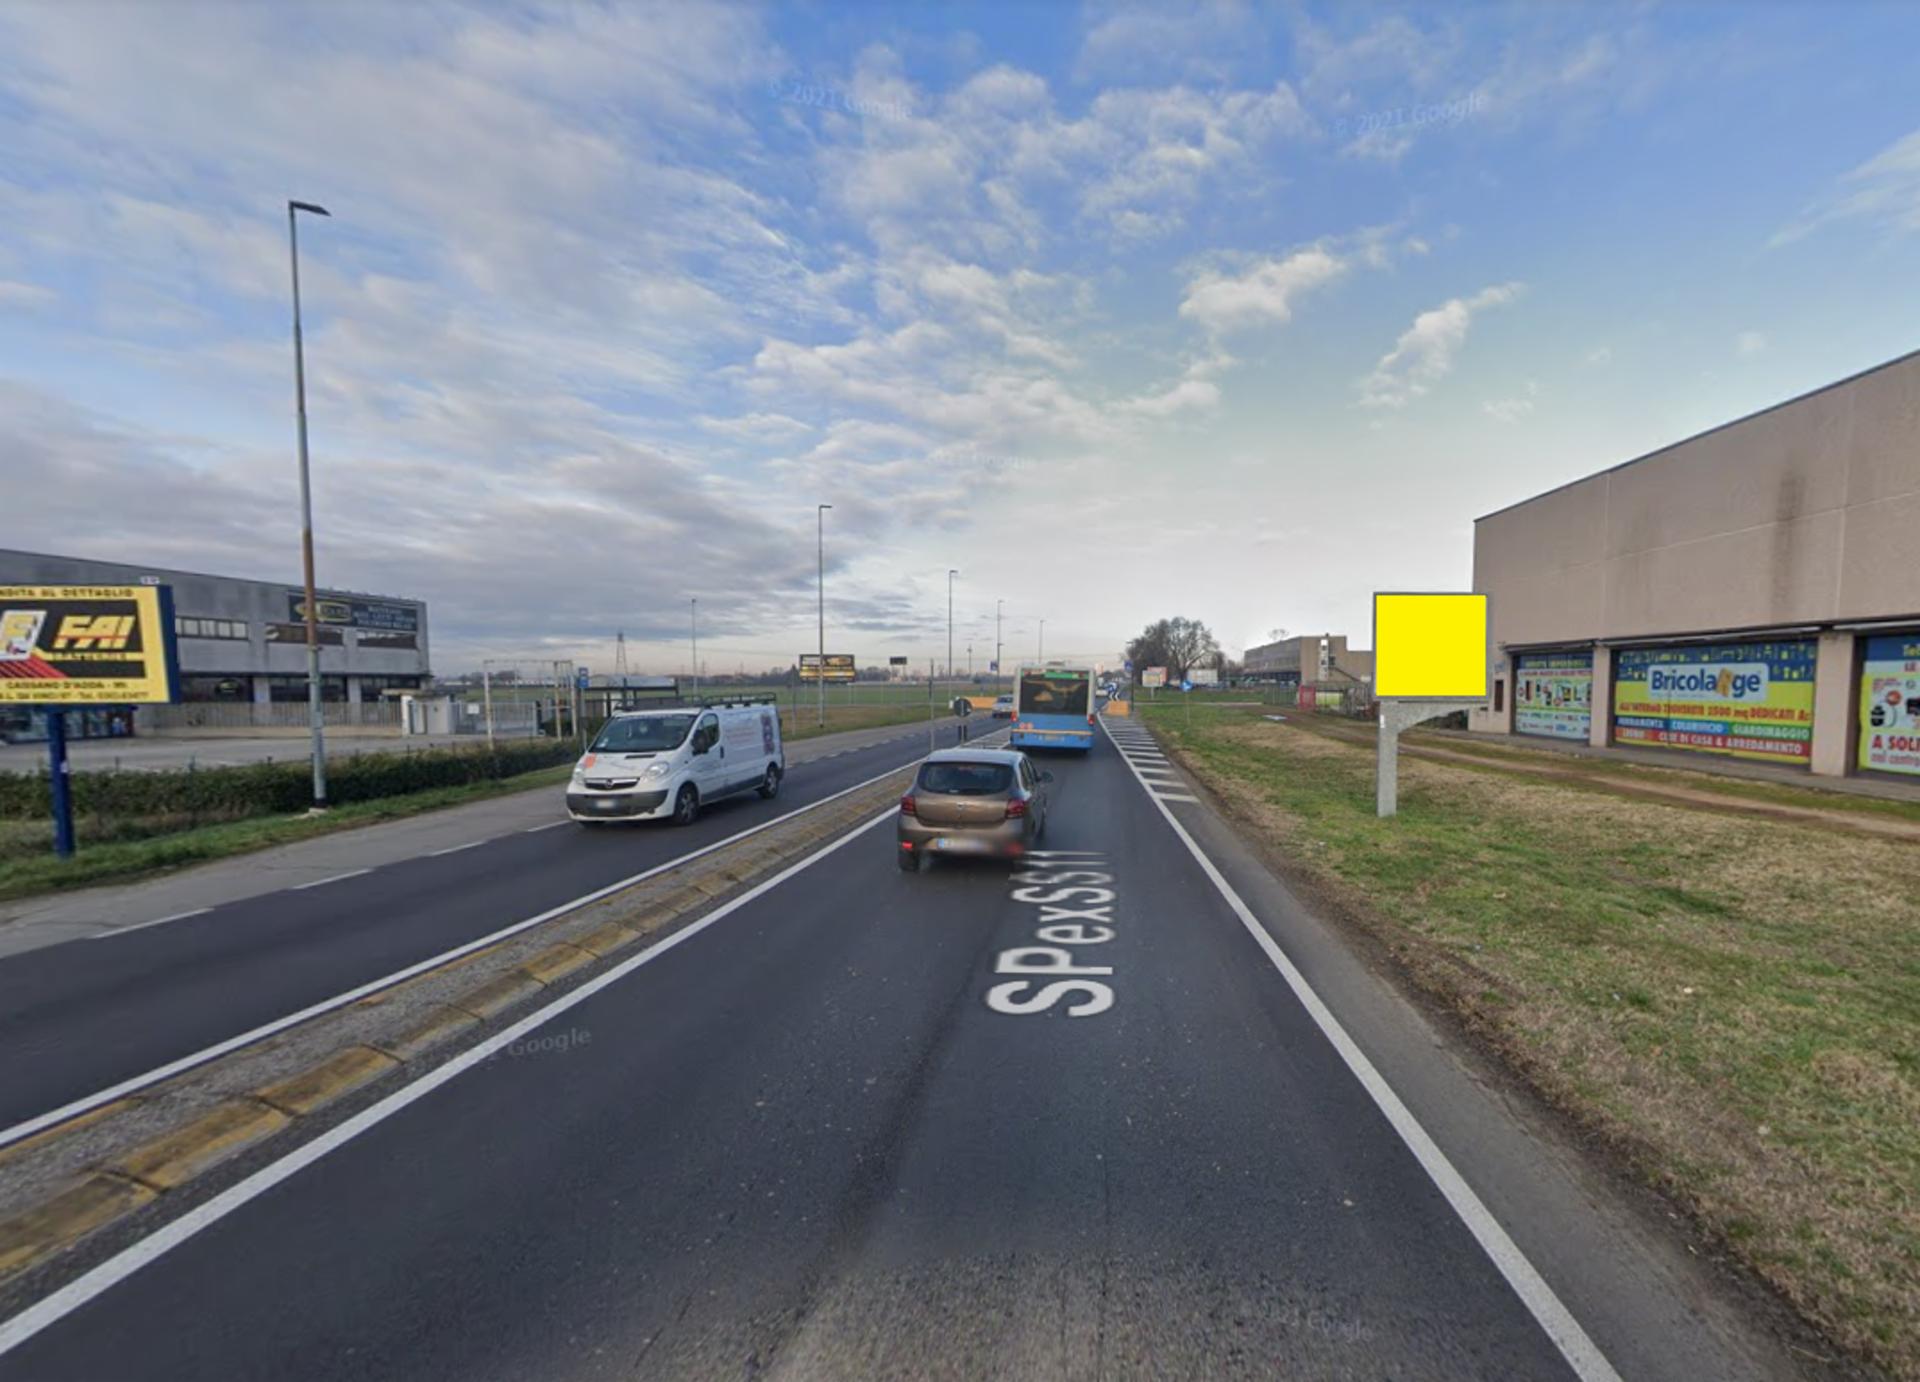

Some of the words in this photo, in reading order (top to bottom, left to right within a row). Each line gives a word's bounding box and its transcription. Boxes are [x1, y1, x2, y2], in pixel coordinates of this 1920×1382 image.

[53, 616, 136, 649] FAI
[1732, 721, 1811, 740] GIARDINAGGIO
[1726, 736, 1804, 755] ARREDAMENTO
